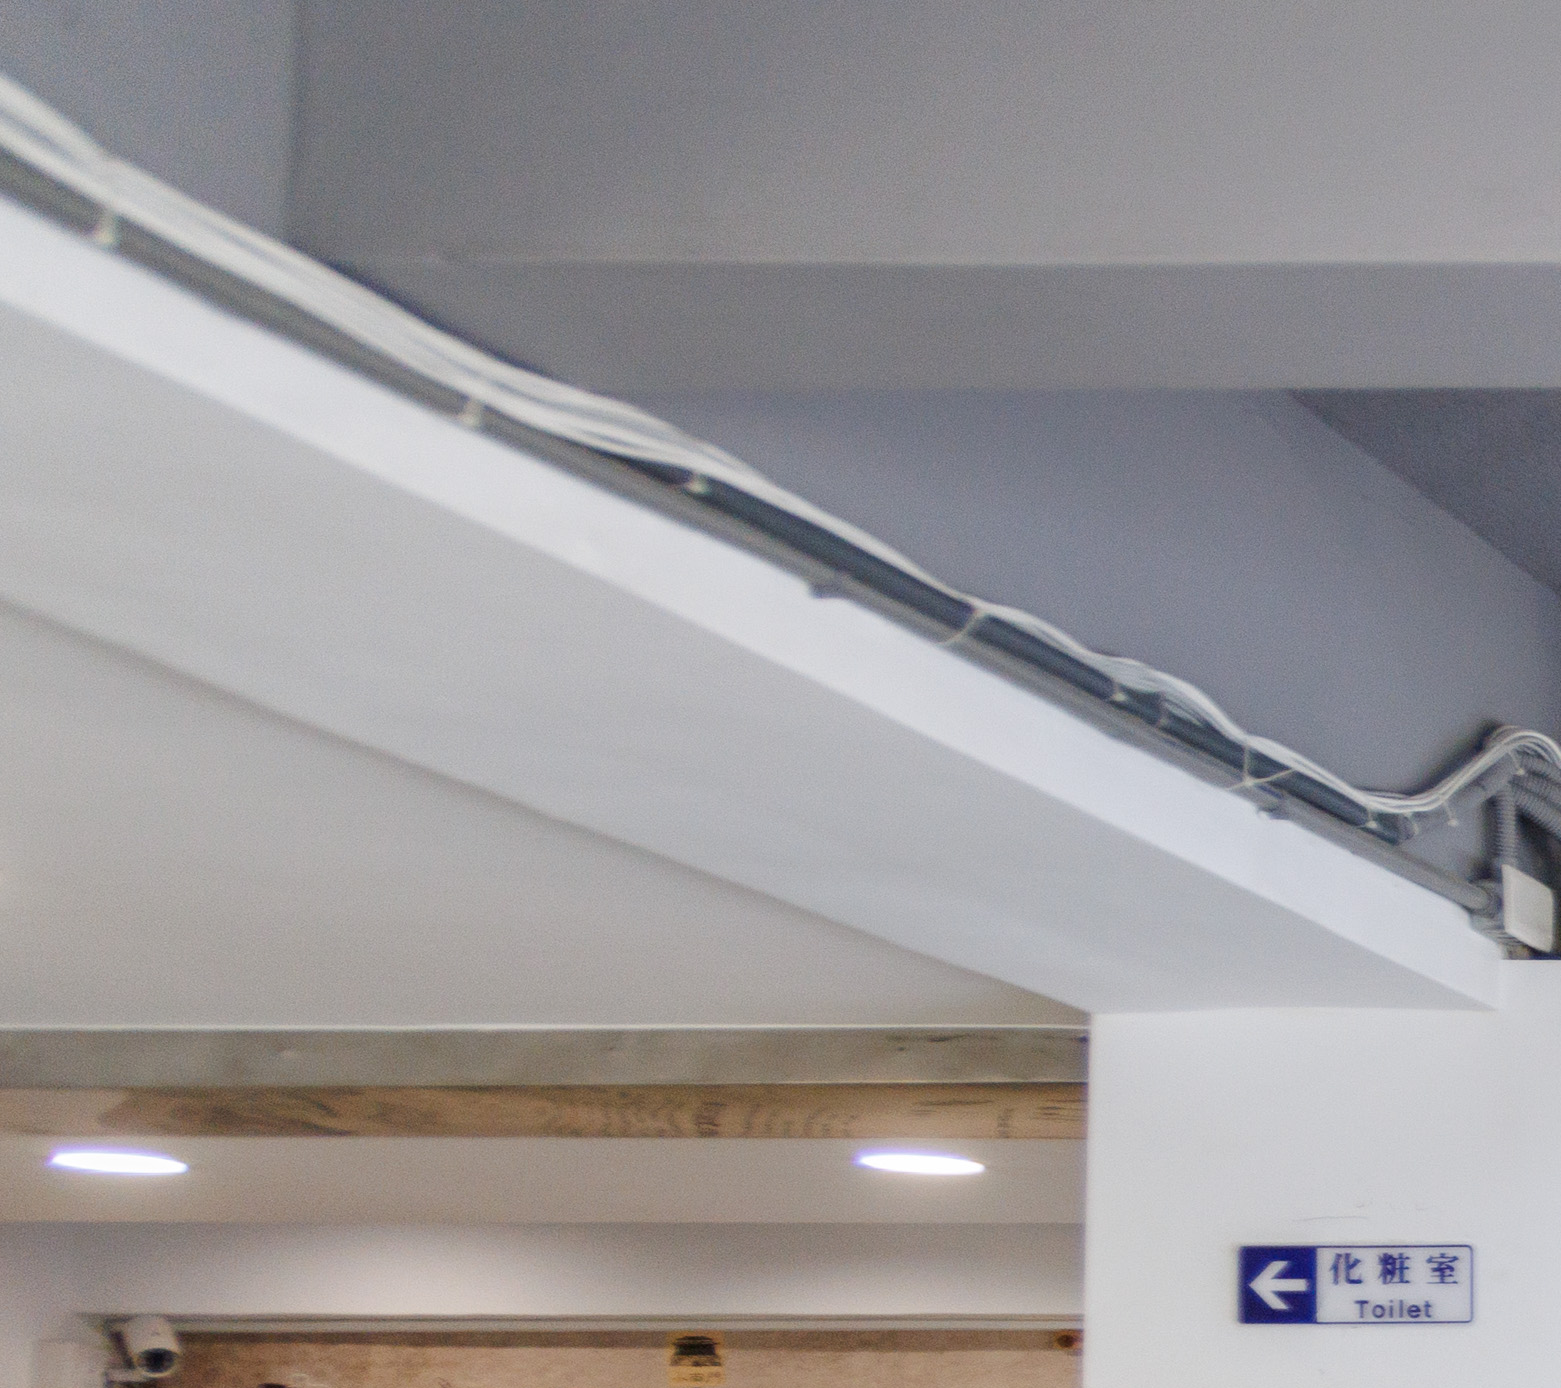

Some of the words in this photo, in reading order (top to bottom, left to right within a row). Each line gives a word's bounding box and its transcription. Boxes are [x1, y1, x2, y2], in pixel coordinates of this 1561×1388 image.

[1328, 1254, 1460, 1288] 化粧室
[1354, 1299, 1432, 1318] Toilet
